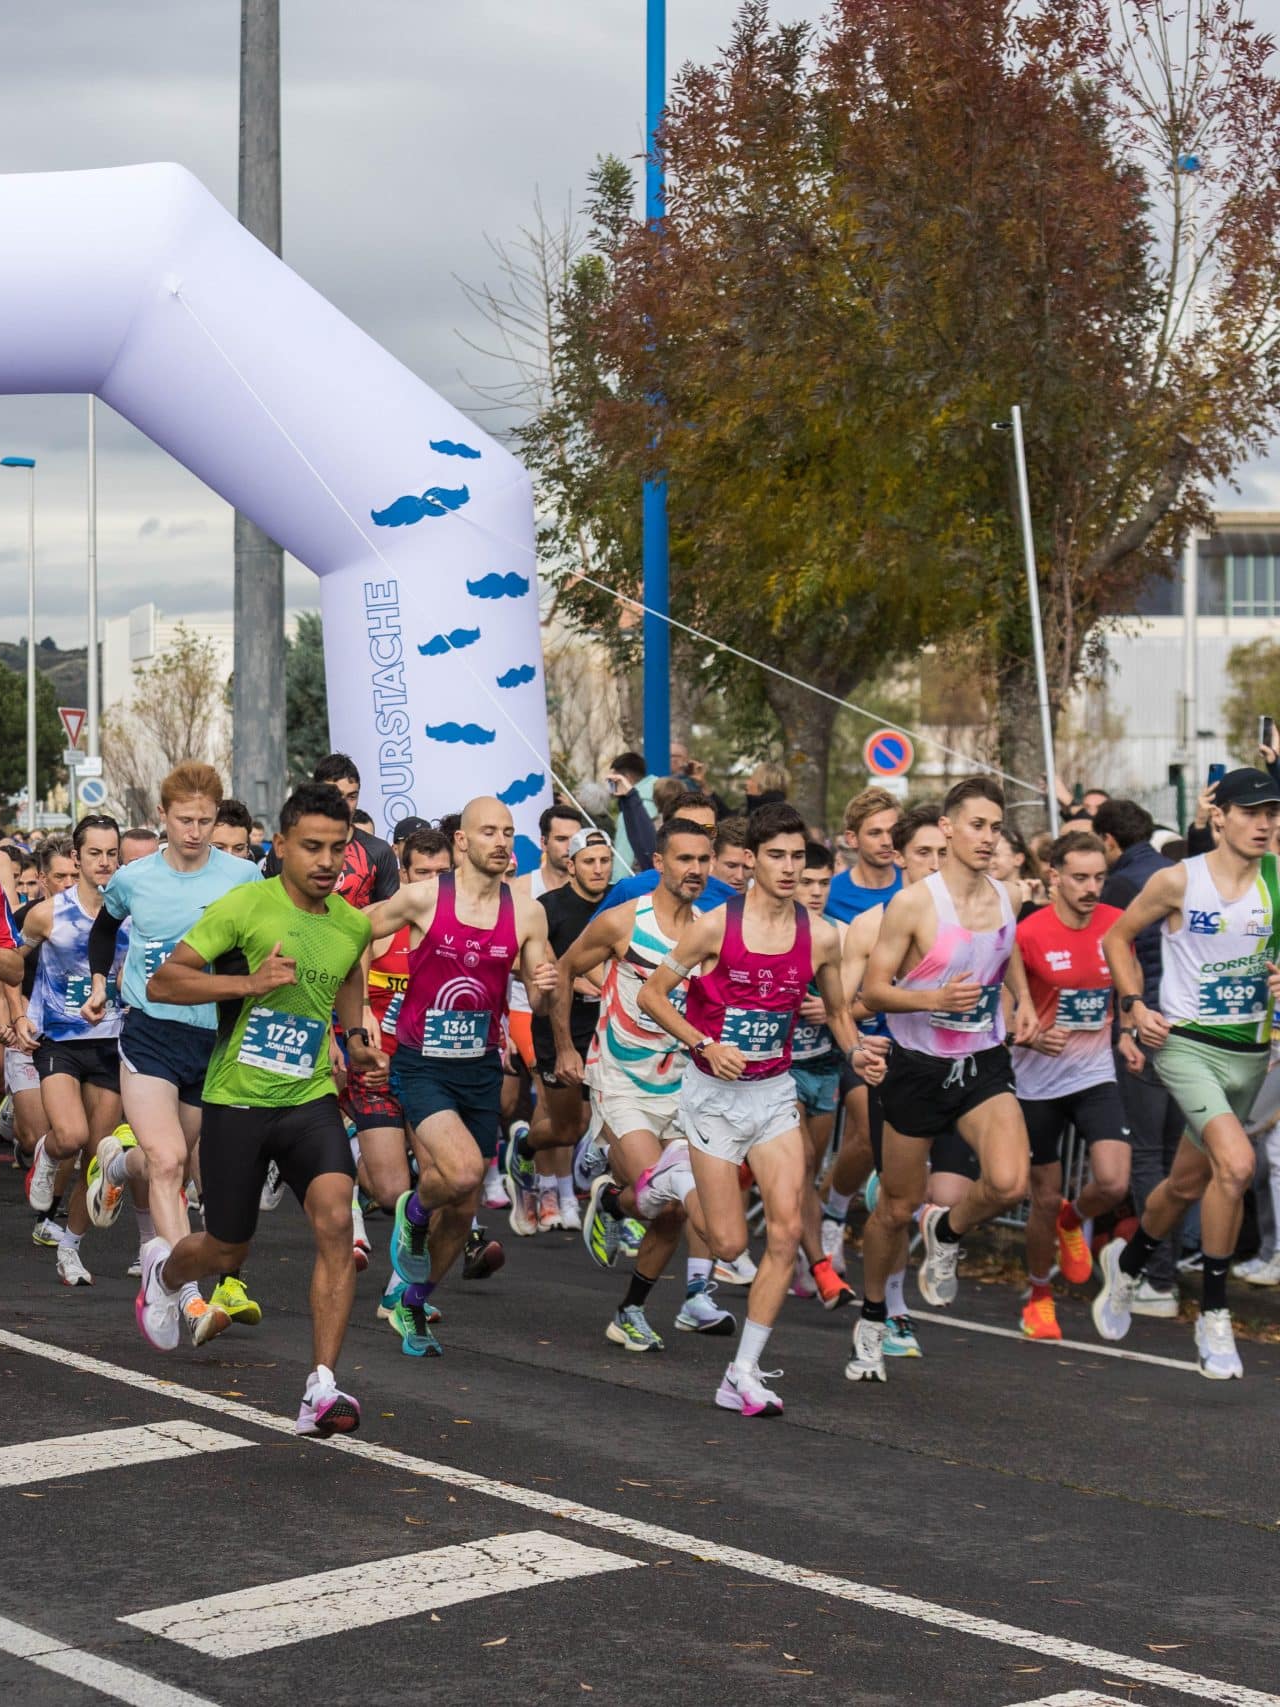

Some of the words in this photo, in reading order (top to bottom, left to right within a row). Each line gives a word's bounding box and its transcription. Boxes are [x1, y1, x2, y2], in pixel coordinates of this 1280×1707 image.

[364, 579, 419, 842] OURSTACHE
[1189, 909, 1222, 927] TAC
[1215, 985, 1256, 1000] 1629
[266, 1023, 309, 1047] 1729
[442, 1020, 476, 1034] 1361
[738, 1021, 780, 1037] 2129
[264, 1041, 302, 1055] JONATHAN
